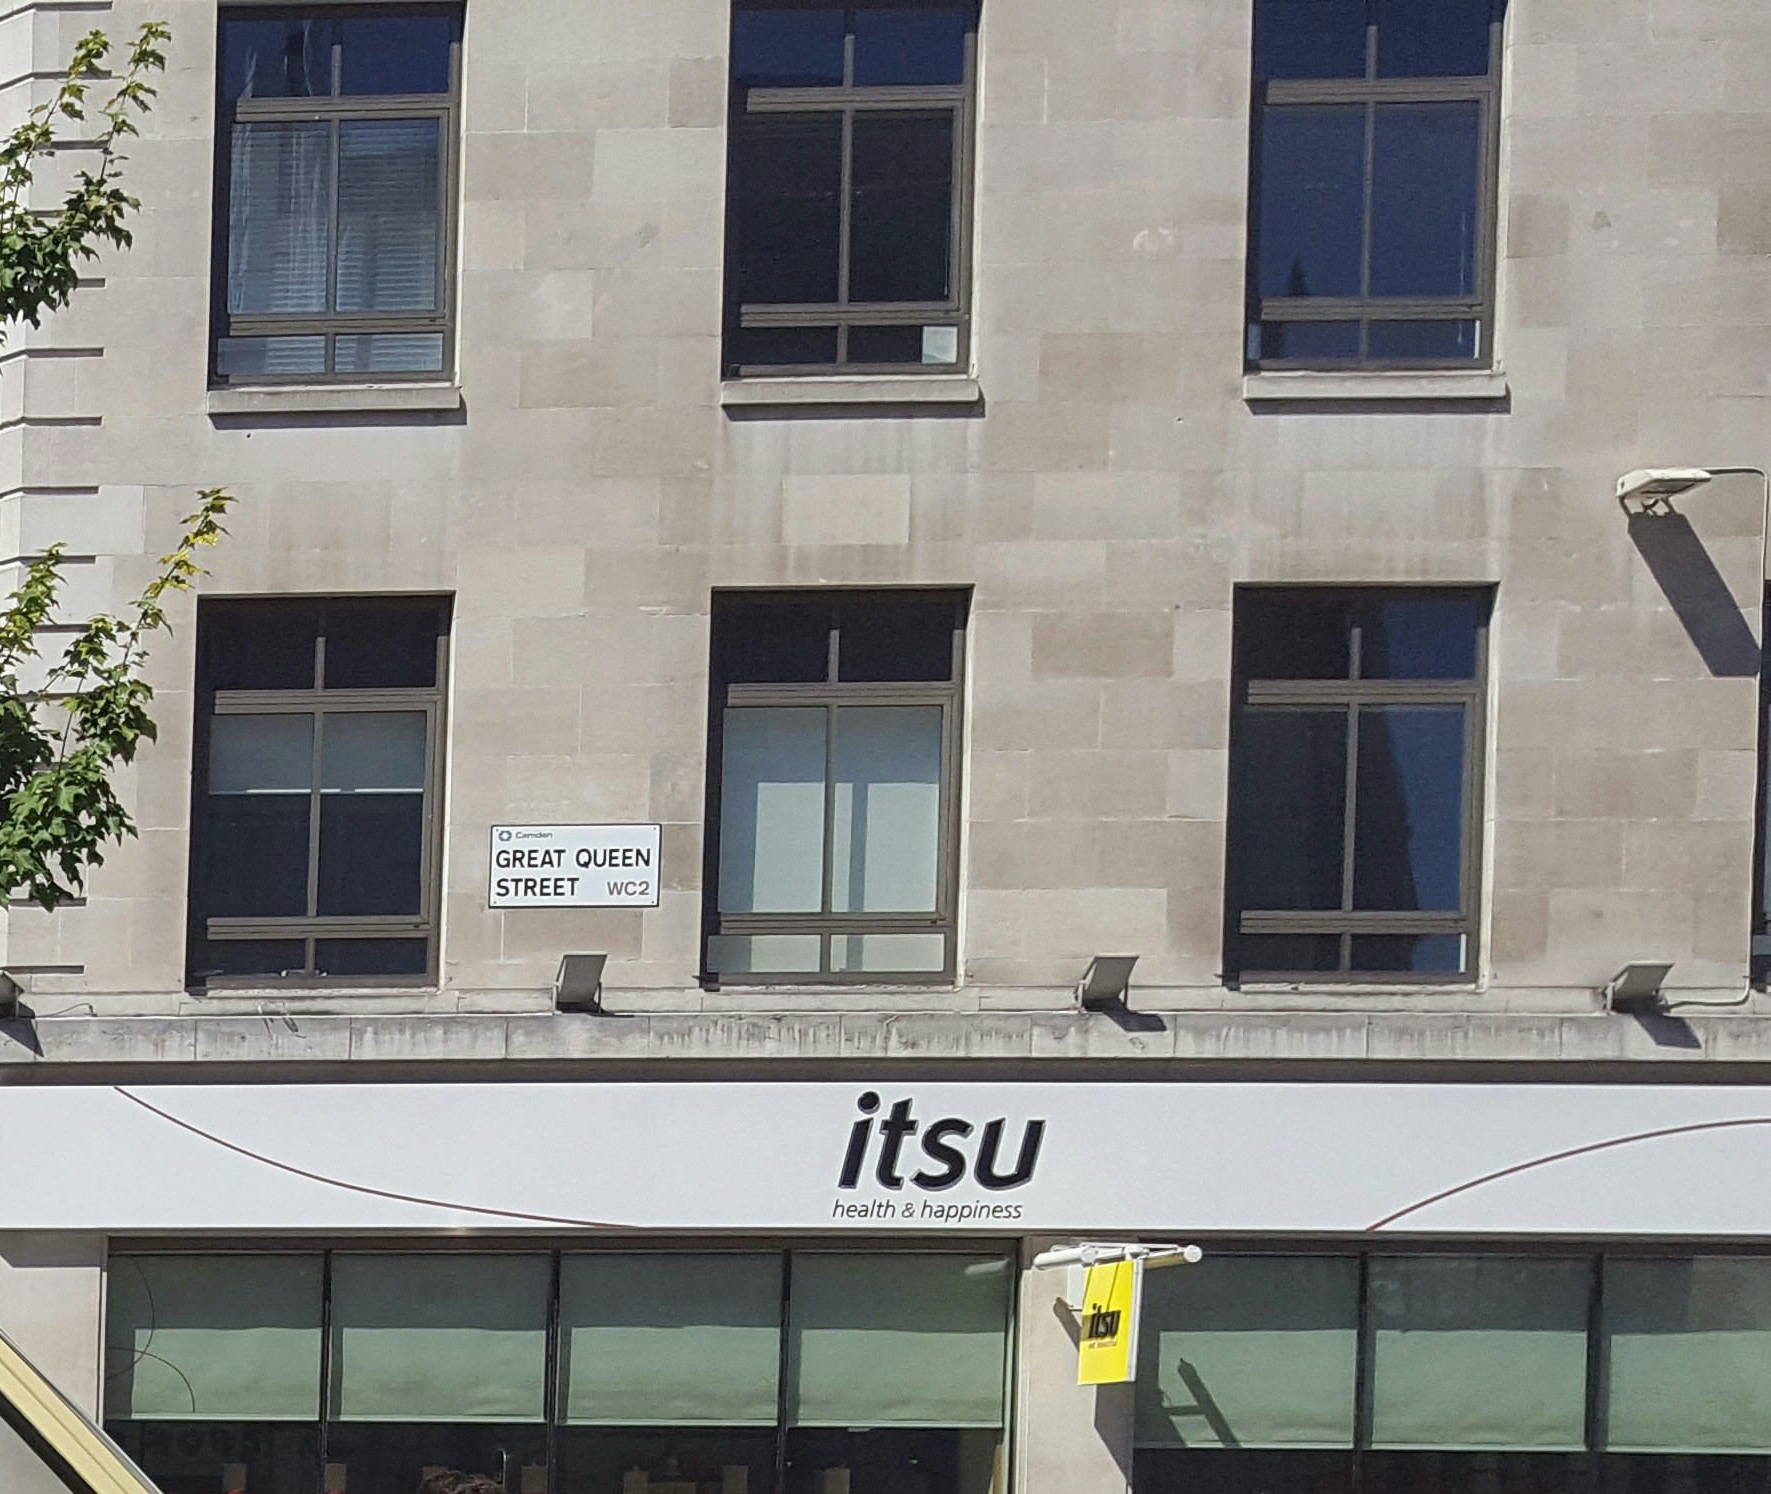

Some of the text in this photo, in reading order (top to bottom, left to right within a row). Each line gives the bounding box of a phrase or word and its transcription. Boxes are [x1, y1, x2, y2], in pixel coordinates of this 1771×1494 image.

[515, 831, 553, 839] Camden
[495, 848, 651, 869] GREAT QUEEN
[495, 877, 650, 897] STREET WC2
[837, 1090, 1047, 1192] itsu
[832, 1199, 1023, 1224] health & happiness
[1088, 1302, 1122, 1340] itsu
